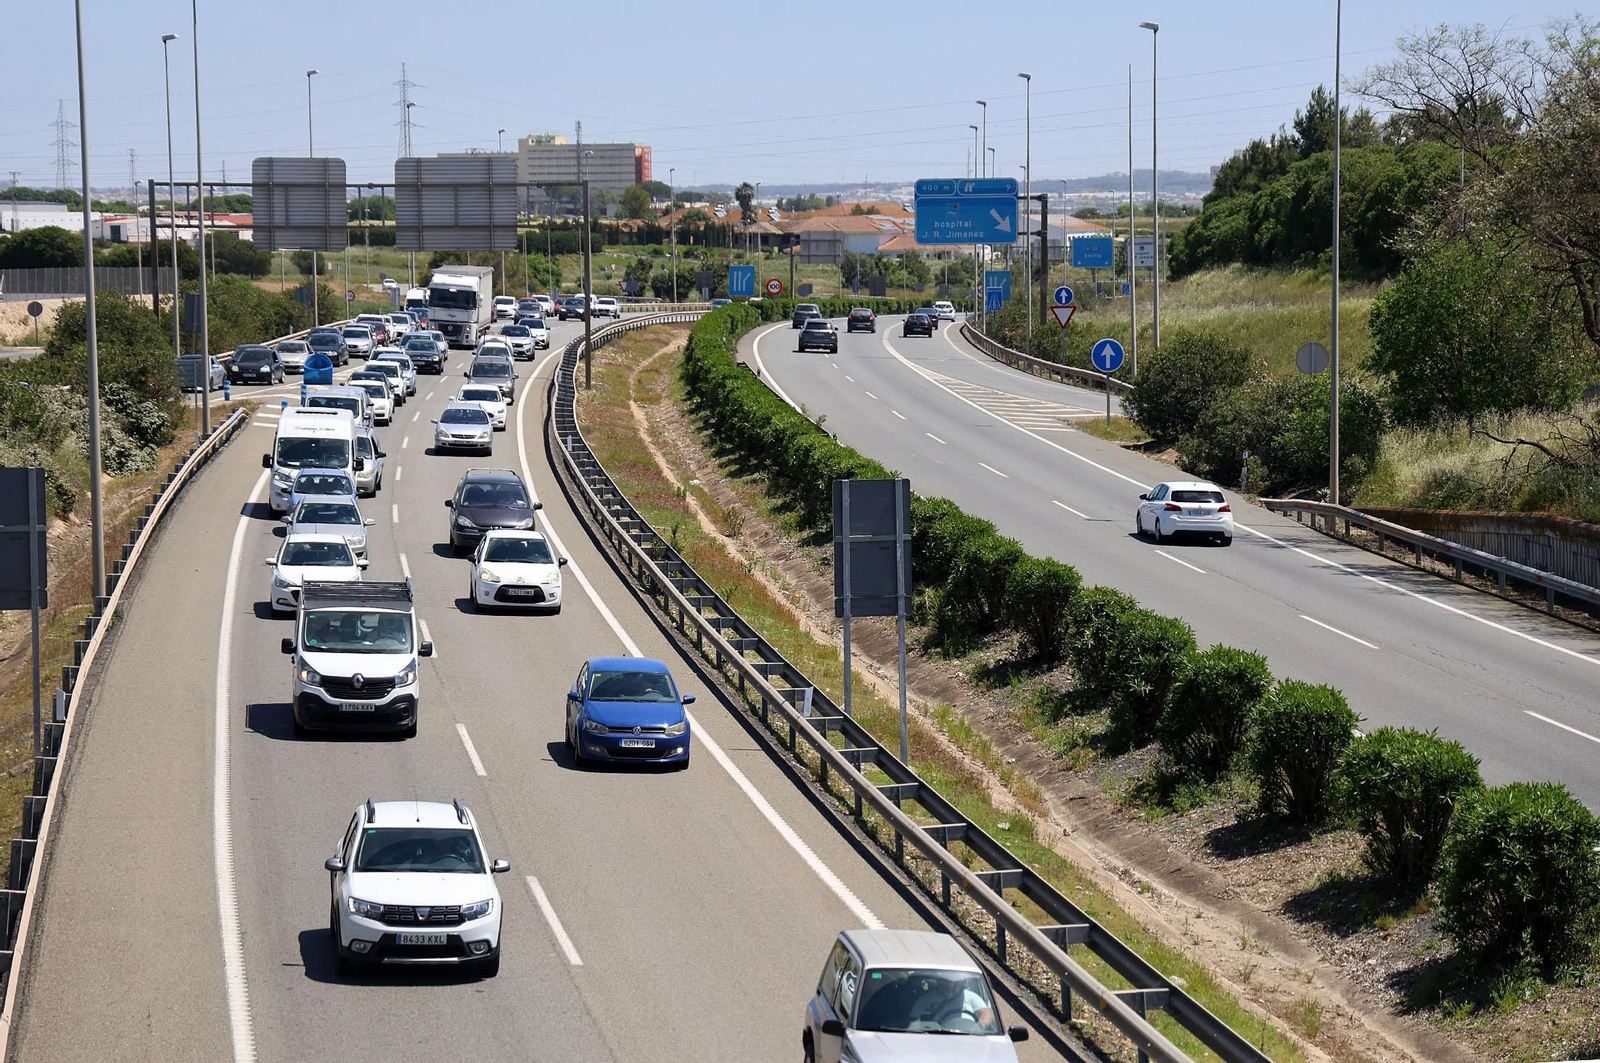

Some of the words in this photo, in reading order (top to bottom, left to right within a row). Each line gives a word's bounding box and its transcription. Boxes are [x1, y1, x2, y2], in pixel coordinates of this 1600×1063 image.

[934, 221, 972, 229] hospital
[402, 935, 425, 944] 8433
[428, 935, 445, 944] KXL
